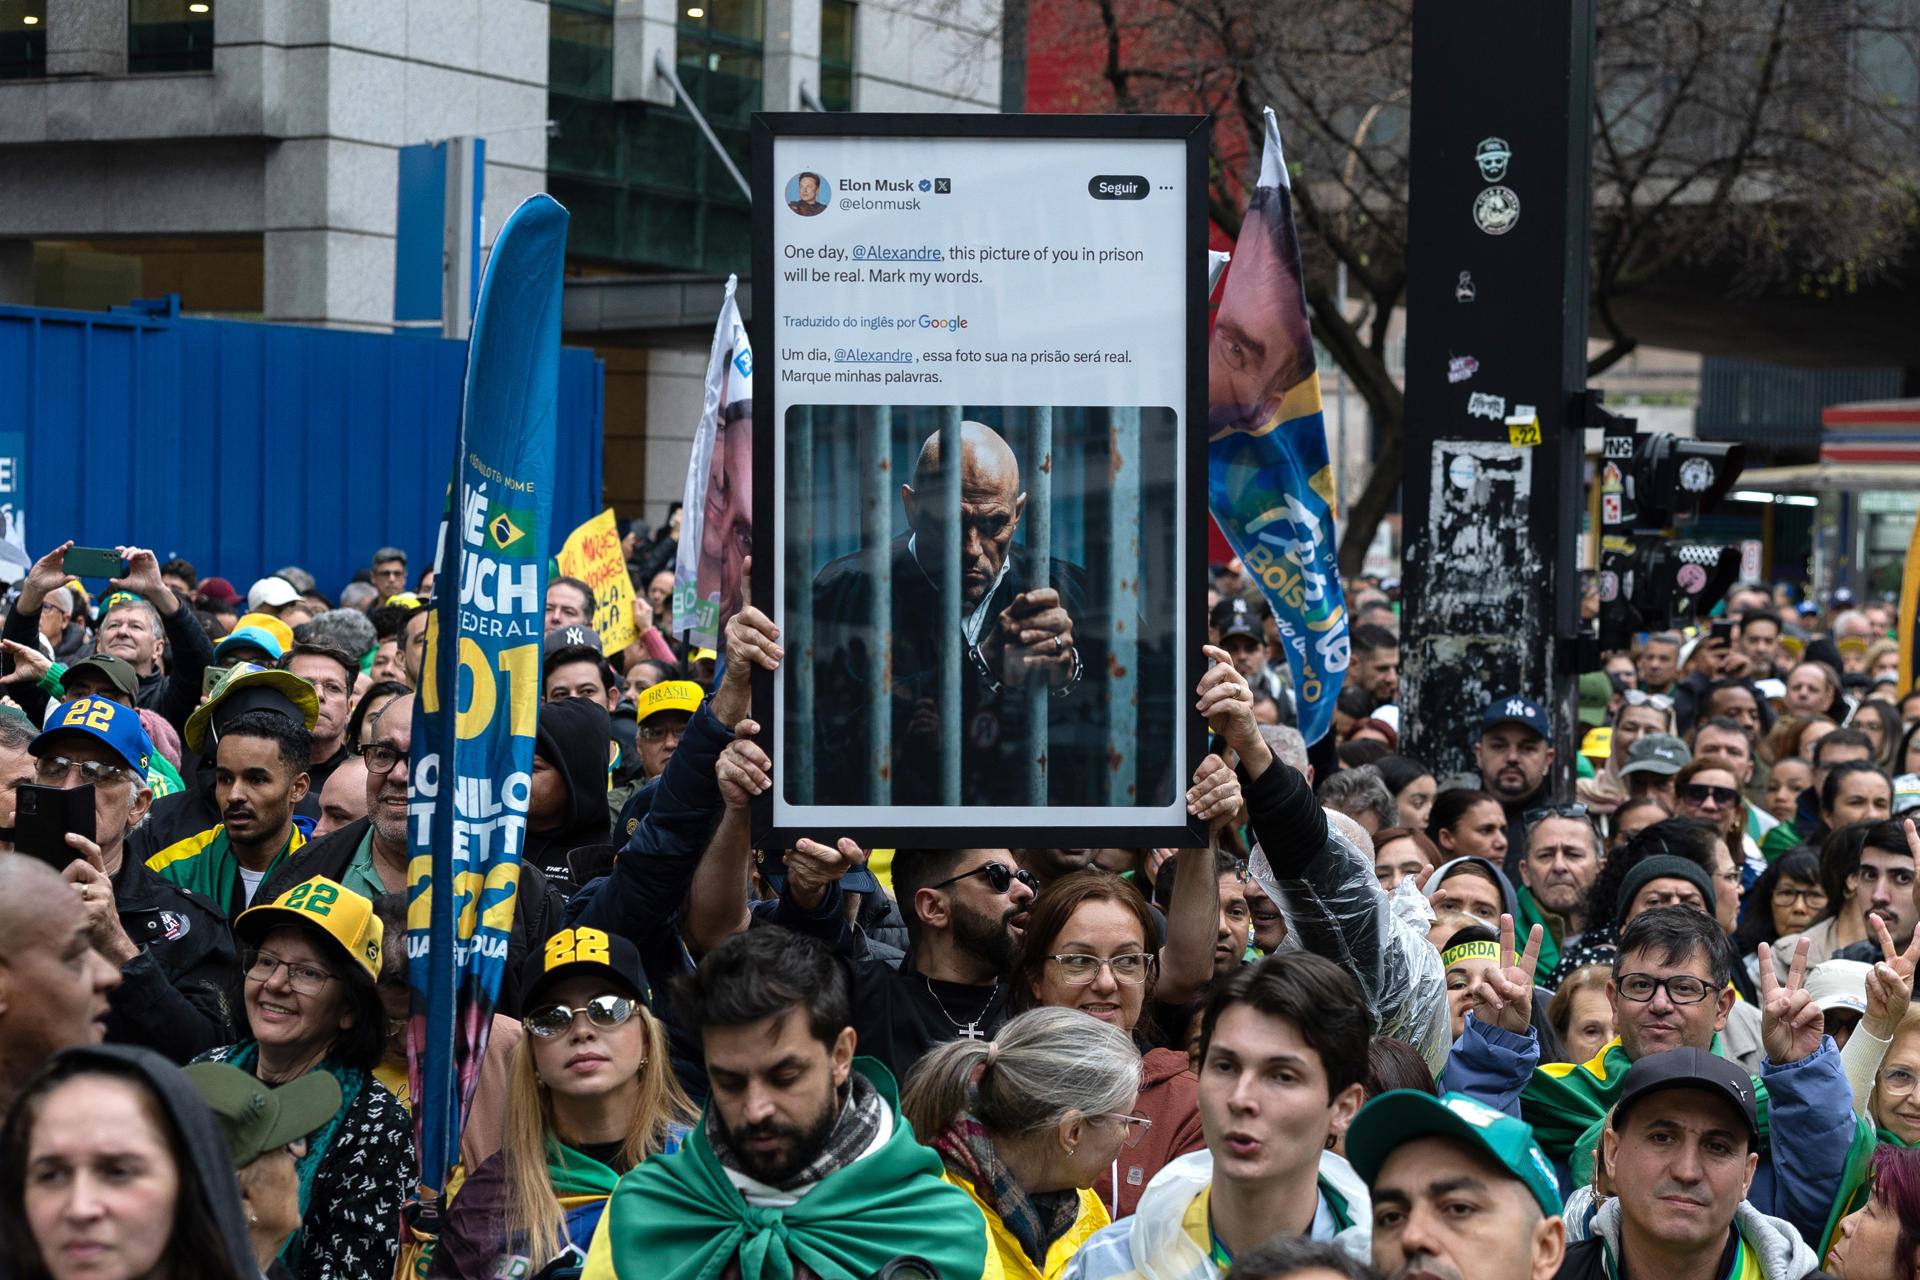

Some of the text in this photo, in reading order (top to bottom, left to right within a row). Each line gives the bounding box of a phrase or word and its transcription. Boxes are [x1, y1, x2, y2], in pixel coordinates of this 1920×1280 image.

[839, 178, 871, 192] Elon
[875, 178, 914, 192] Musk
[1099, 182, 1138, 196] Seguir
[839, 197, 921, 211] @elonmusk
[784, 244, 1144, 264] One day, @Alexandre, this picture of you in prison
[784, 268, 983, 286] will be real. Mark my words.
[783, 314, 968, 333] Traduzido do inglês por Google
[781, 348, 804, 361] Um
[807, 347, 831, 363] dia,
[833, 348, 913, 364] @Alexandre
[922, 351, 952, 362] essa
[956, 349, 982, 362] foto
[984, 351, 1008, 363] sua
[1011, 351, 1027, 363] na
[1030, 350, 1070, 365] prisão
[1073, 350, 1101, 363] será
[1104, 350, 1132, 364] real.
[781, 369, 943, 385] Marque minhas palavras.
[62, 699, 115, 732] 22
[284, 883, 339, 917] 22
[544, 926, 610, 972] 22
[1441, 942, 1496, 967] ACORDA
